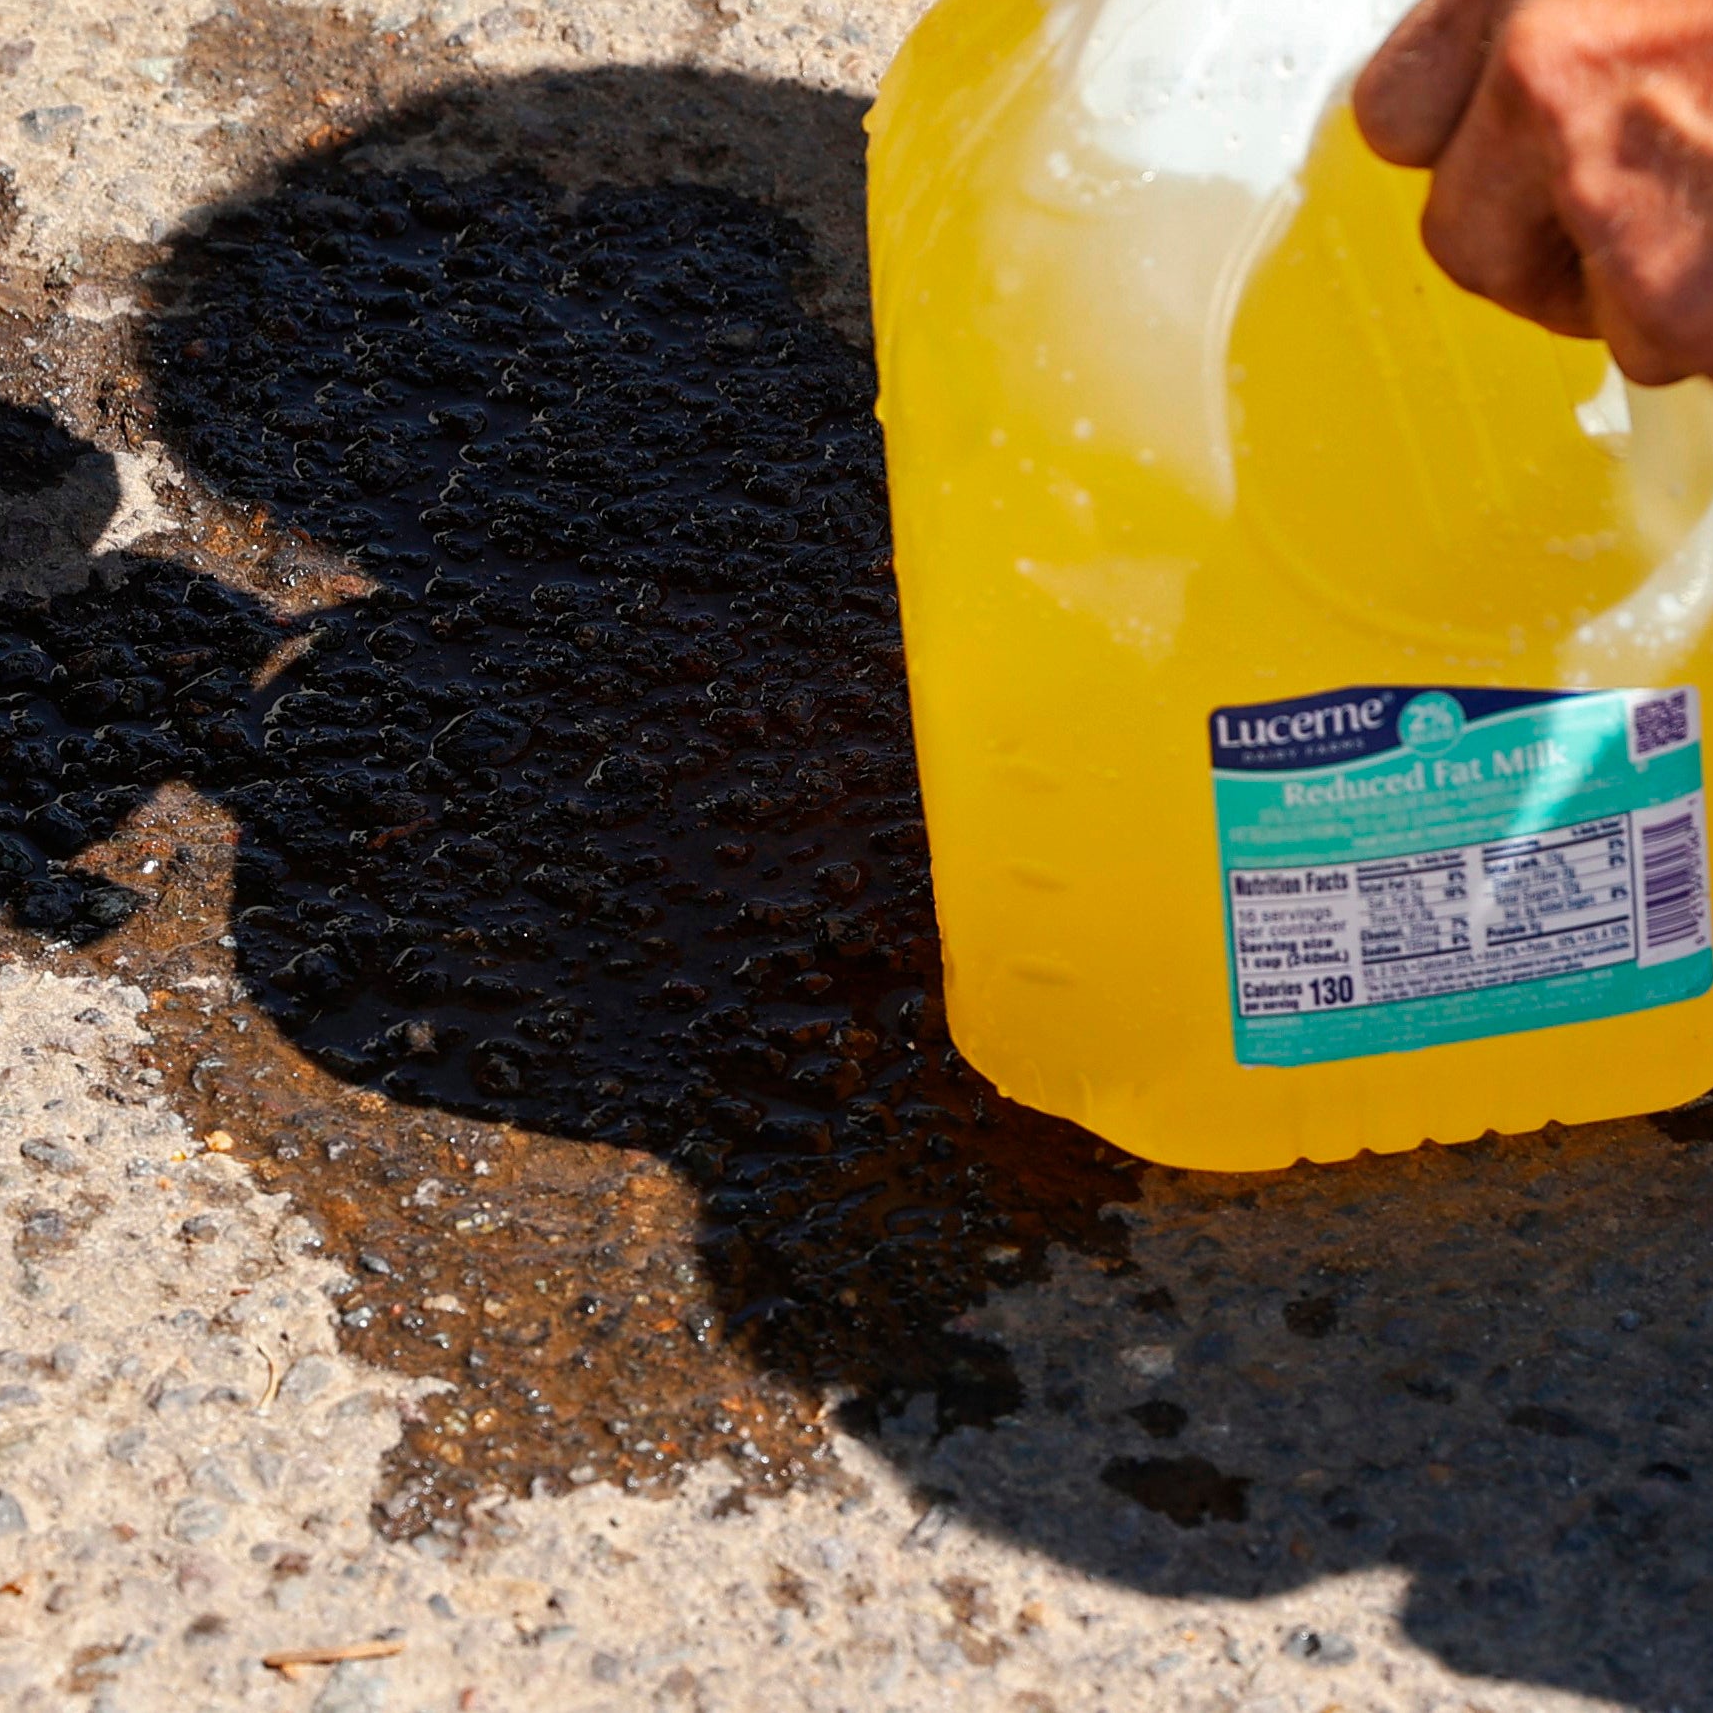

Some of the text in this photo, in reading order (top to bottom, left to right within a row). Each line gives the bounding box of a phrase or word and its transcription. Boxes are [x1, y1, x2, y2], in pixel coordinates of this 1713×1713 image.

[1215, 697, 1386, 749] Lucerne
[1407, 701, 1455, 732] 2%
[1282, 760, 1426, 806] Reduced
[1432, 757, 1484, 787] Fat
[1491, 738, 1569, 777] Milk
[1234, 871, 1349, 896] Nutrition Facts
[1261, 907, 1332, 922] servings
[1269, 919, 1347, 936] container
[1240, 937, 1334, 954] Serving size
[1243, 973, 1354, 1006] Calories 130
